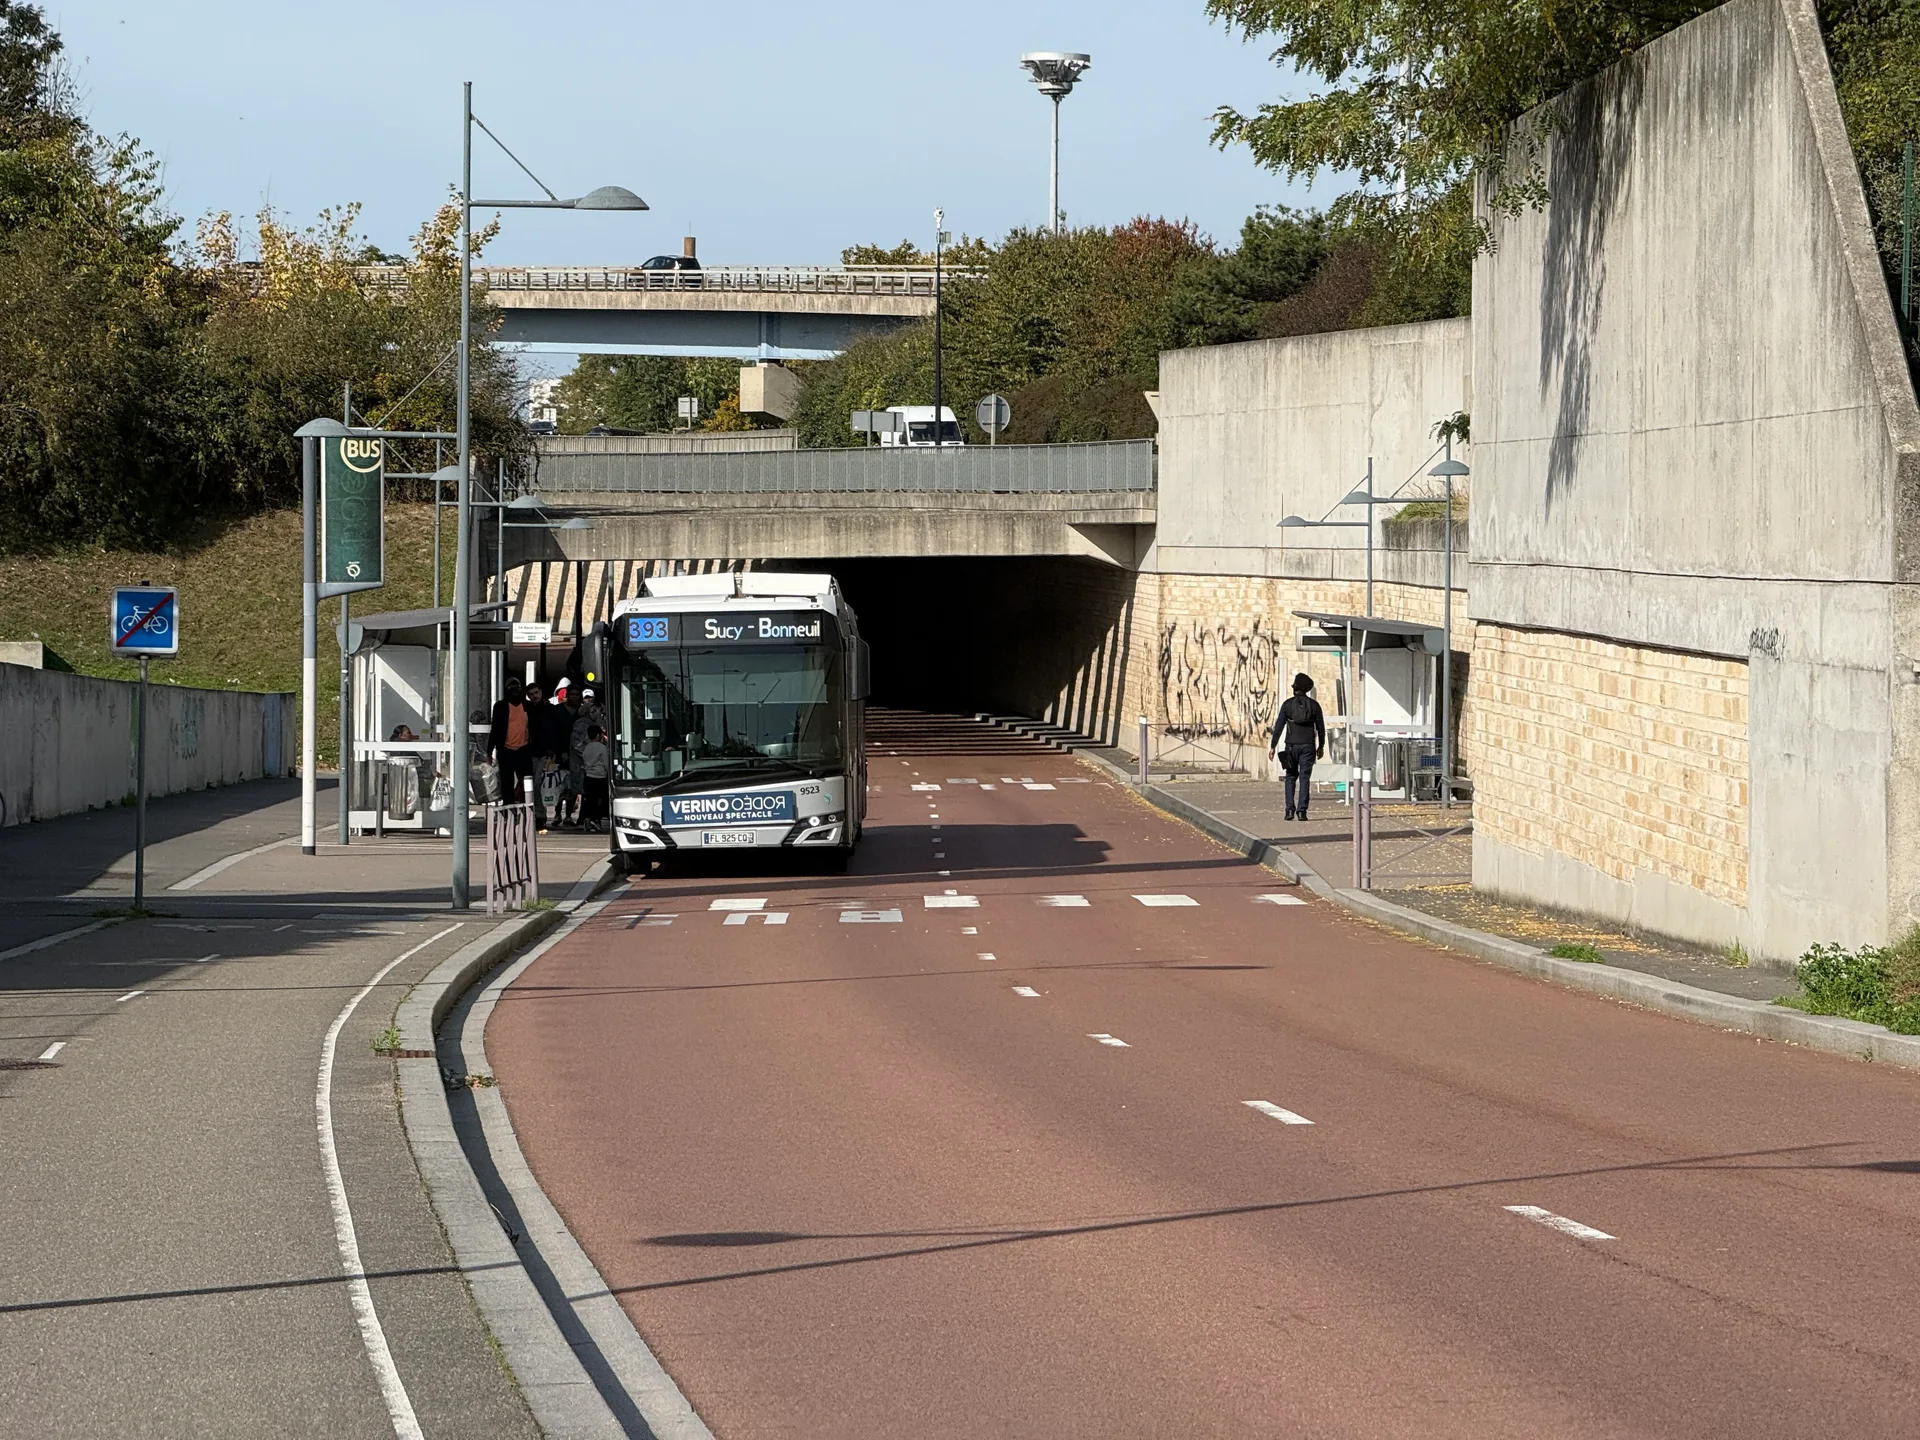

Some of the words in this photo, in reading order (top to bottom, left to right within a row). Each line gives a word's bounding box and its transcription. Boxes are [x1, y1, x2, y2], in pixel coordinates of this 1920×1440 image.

[347, 439, 381, 458] BUS
[629, 620, 668, 639] 393
[704, 618, 743, 640] Sucy
[758, 617, 821, 638] Bonneuil
[800, 785, 820, 796] 9523
[669, 798, 729, 814] VERINO
[684, 813, 724, 821] NOUVEAU
[725, 810, 773, 819] SPECTACLE
